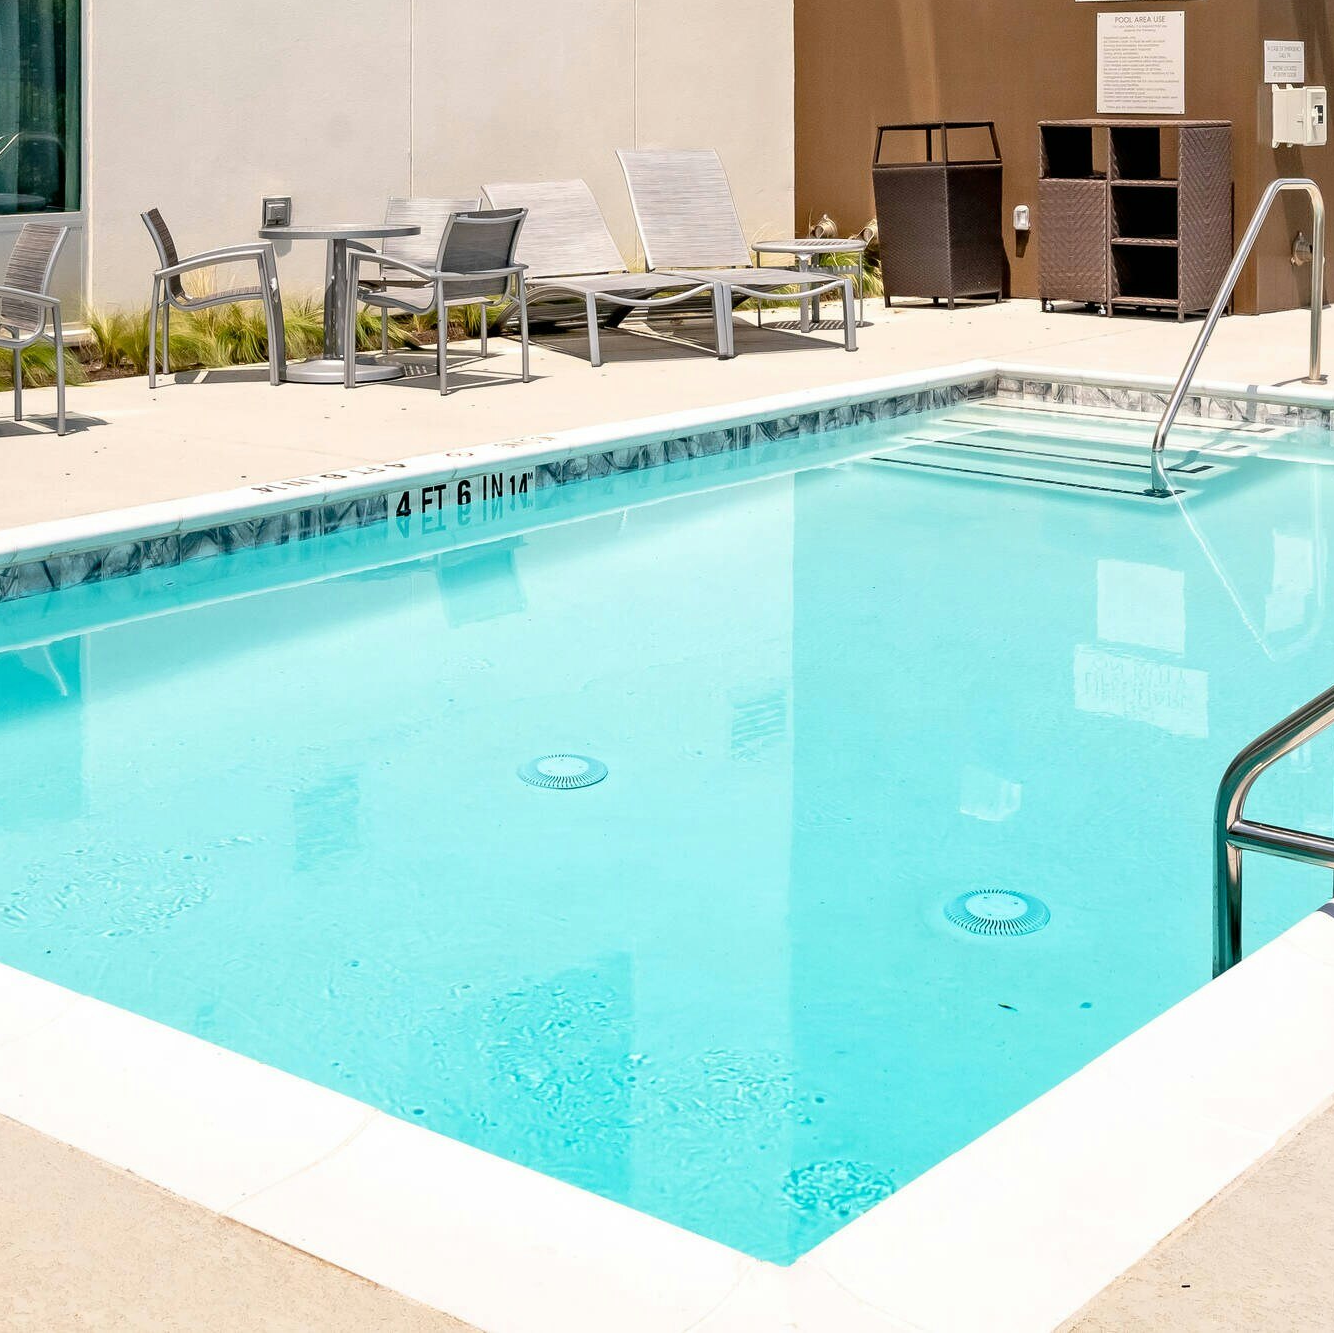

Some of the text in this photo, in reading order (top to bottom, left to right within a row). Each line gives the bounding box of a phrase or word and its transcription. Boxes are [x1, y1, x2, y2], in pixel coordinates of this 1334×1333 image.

[1153, 15, 1166, 23] USE
[396, 491, 412, 516] 4
[421, 484, 447, 514] FT
[457, 480, 472, 506] 6
[482, 472, 504, 501] IN
